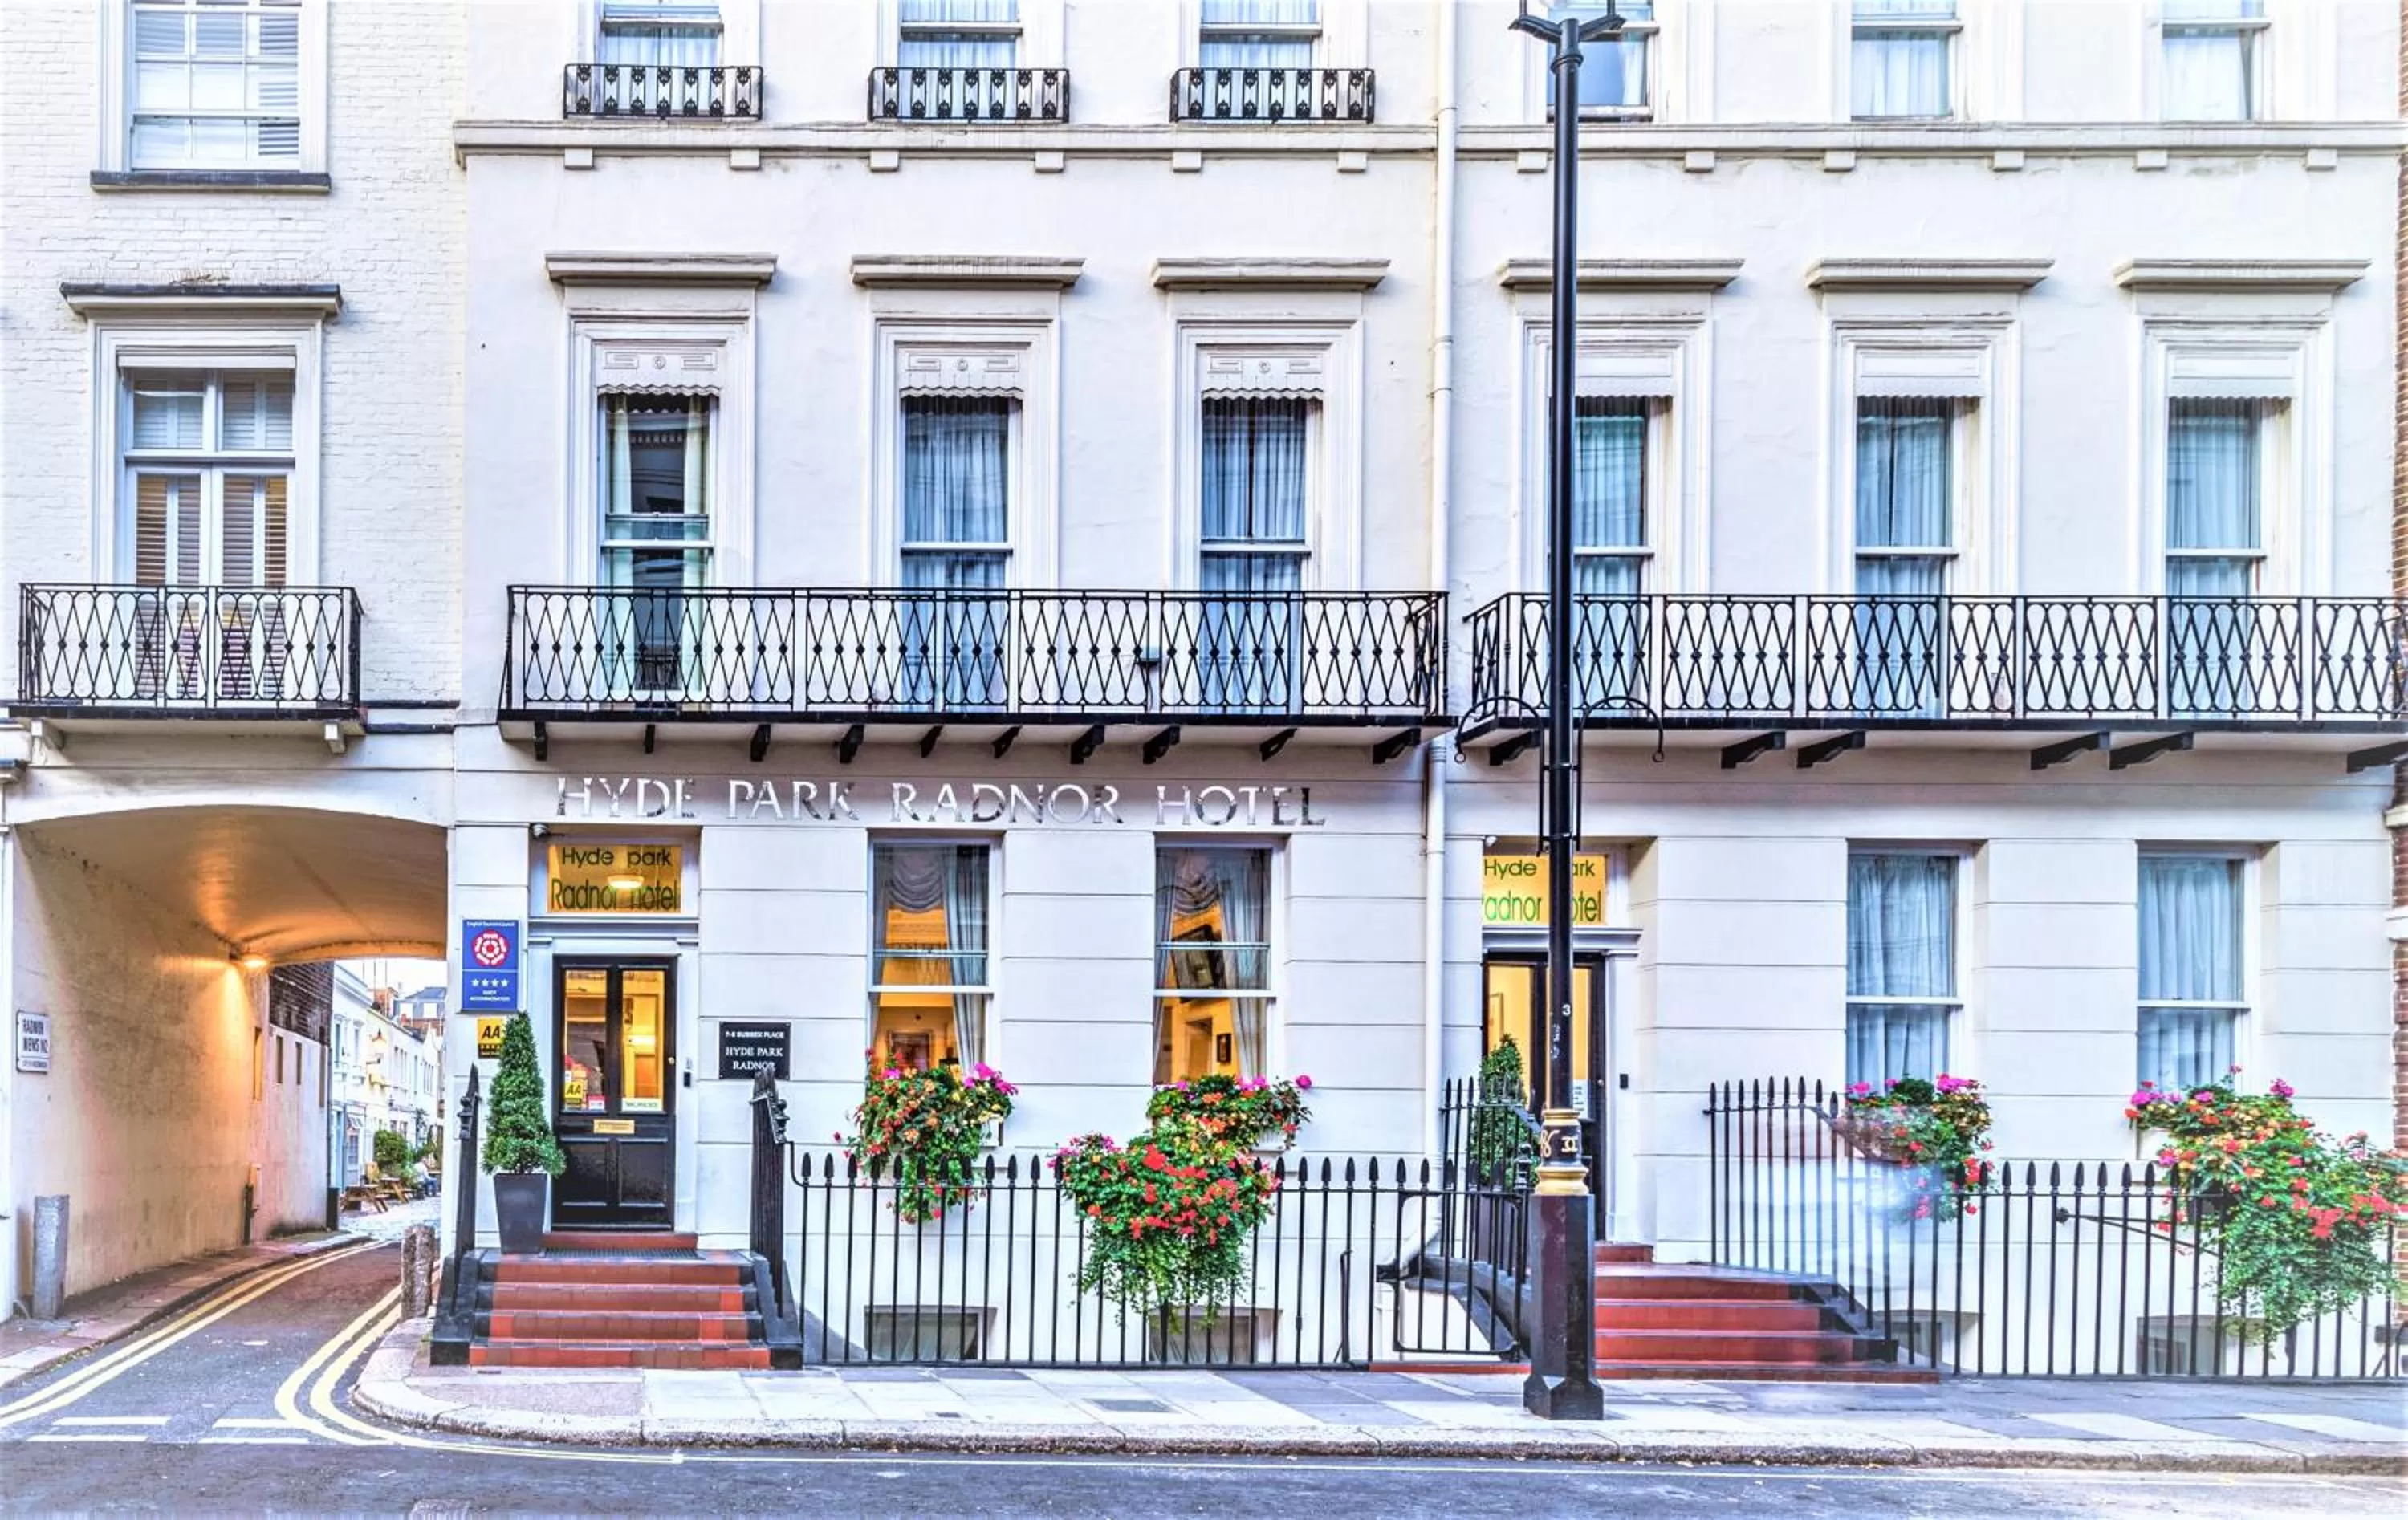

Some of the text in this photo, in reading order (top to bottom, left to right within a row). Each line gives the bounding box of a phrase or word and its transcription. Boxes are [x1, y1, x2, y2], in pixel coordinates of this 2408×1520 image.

[557, 777, 1326, 826] HYDE PARK RADNOR HOTEL
[562, 847, 672, 868] Hyde park
[1484, 858, 1537, 880] Hyde
[1482, 889, 1542, 921] adnor
[1562, 1004, 1571, 1016] 3
[481, 1024, 500, 1039] AA
[725, 1046, 784, 1058] HYDE PARK
[732, 1060, 775, 1071] RADNOR
[566, 1084, 581, 1095] AA
